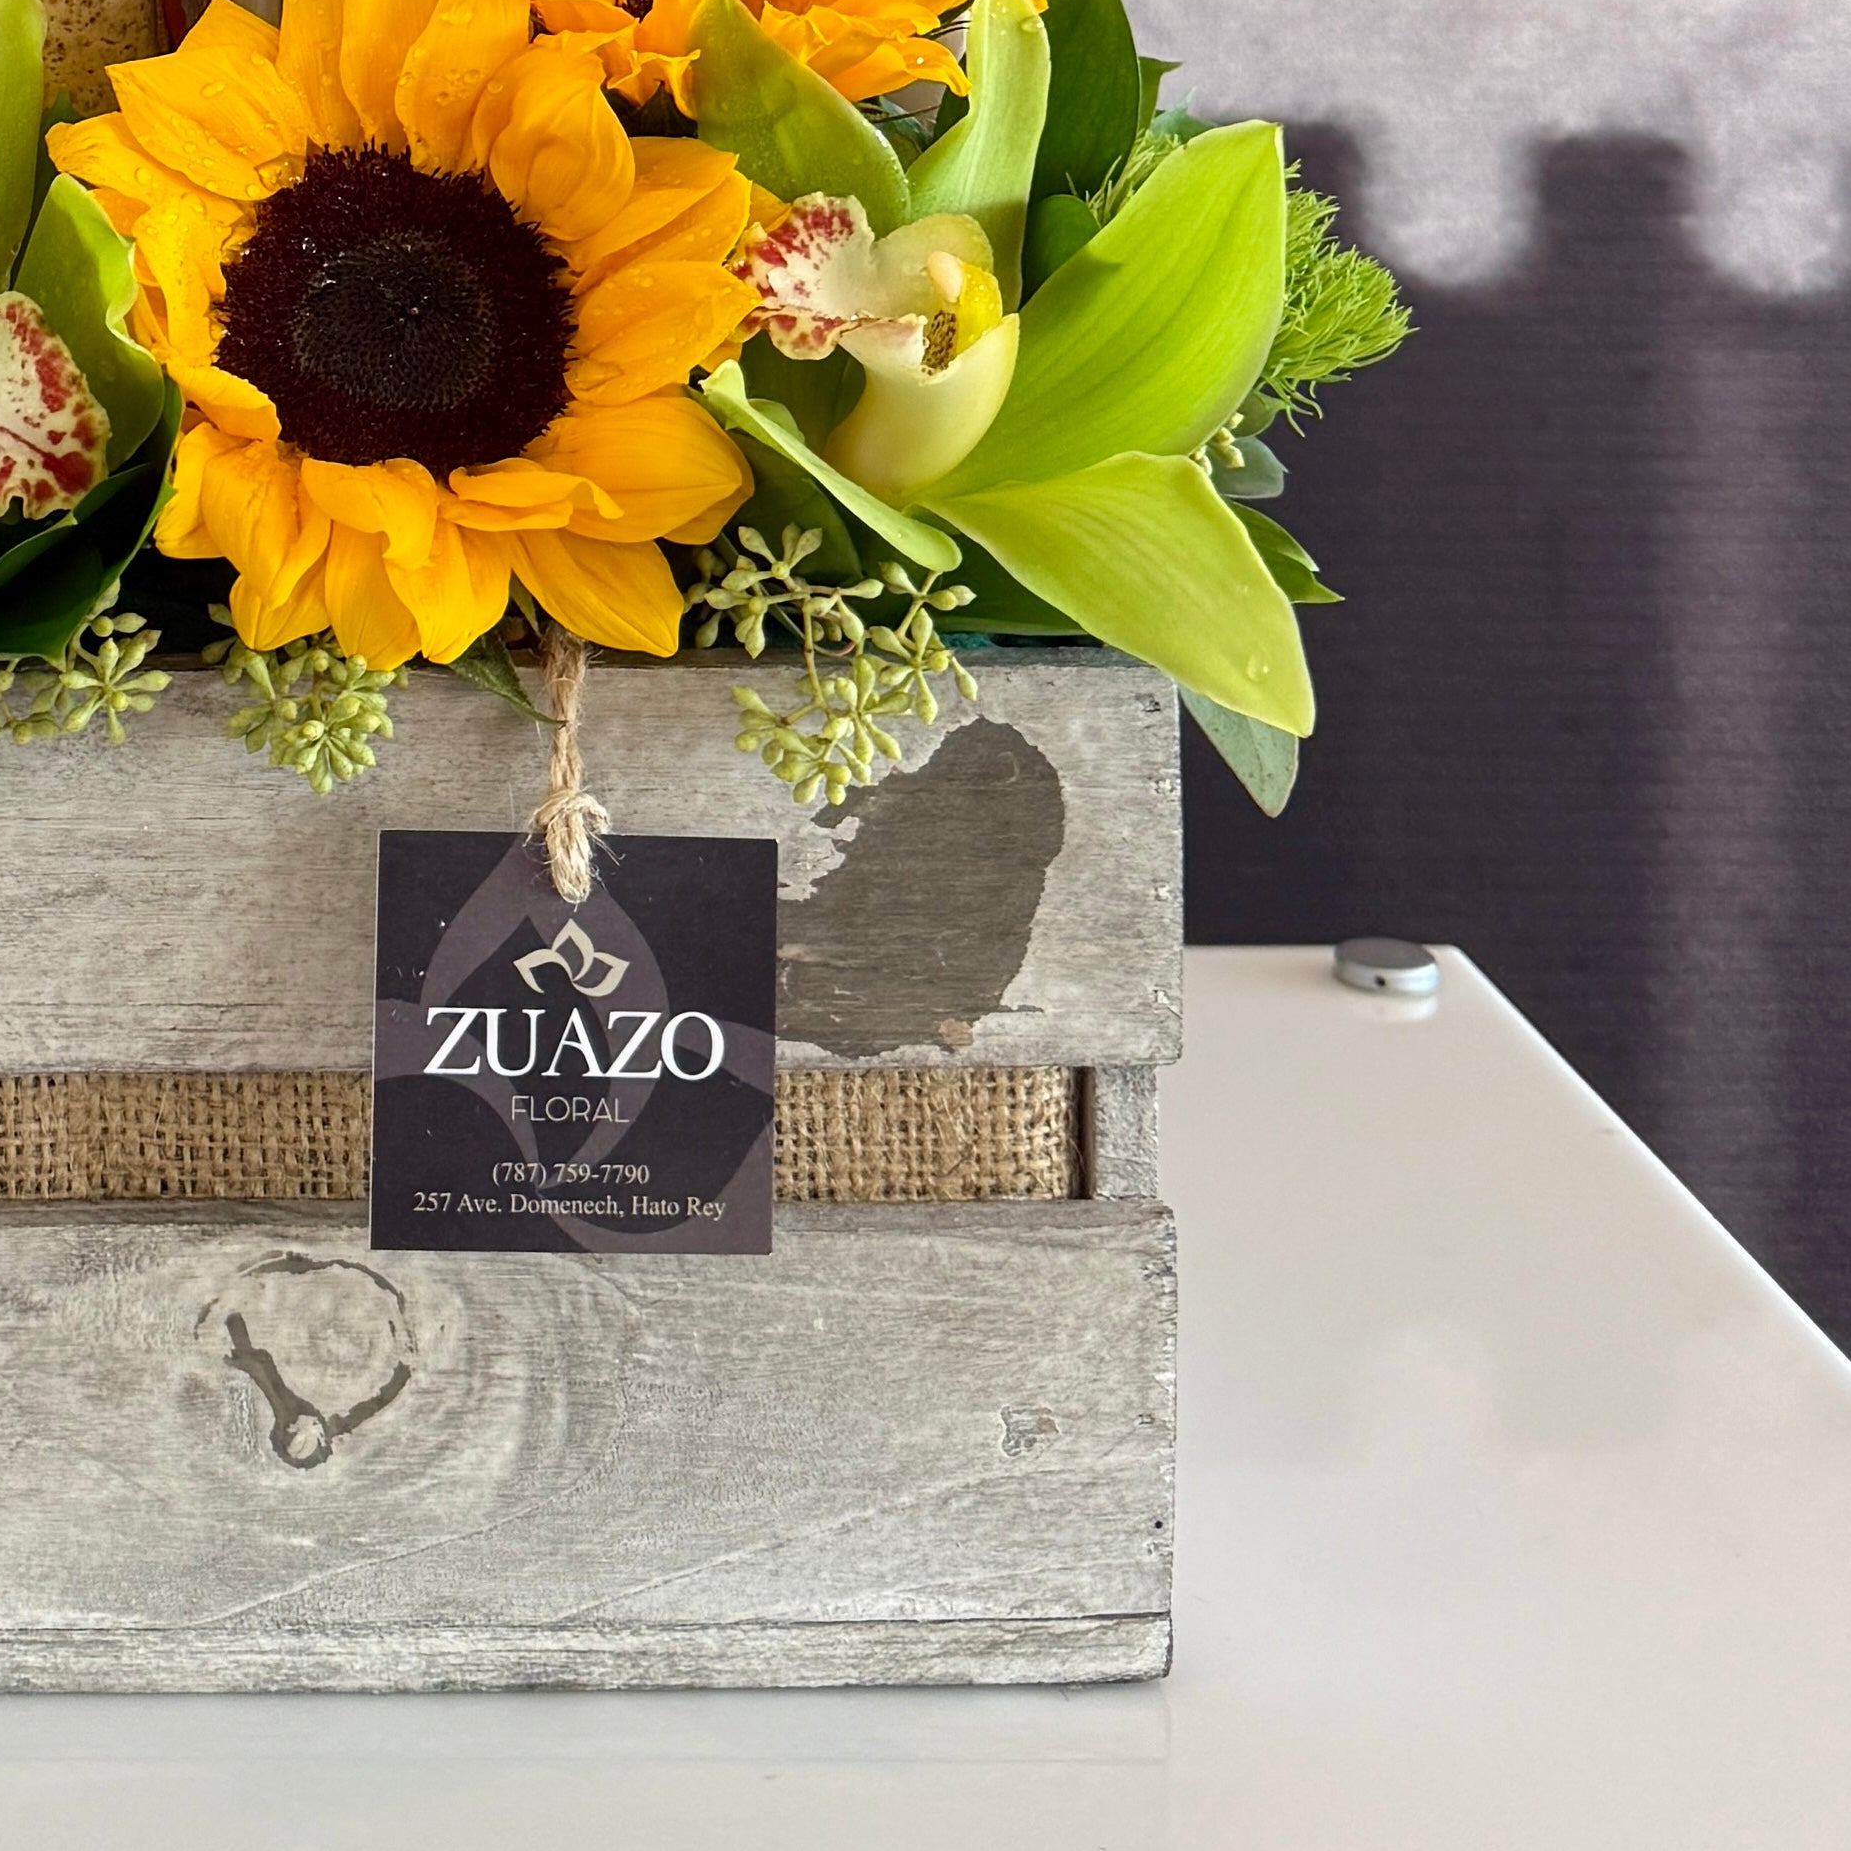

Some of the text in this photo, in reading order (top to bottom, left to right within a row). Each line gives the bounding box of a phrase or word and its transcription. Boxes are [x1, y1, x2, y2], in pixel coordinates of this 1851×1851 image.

[422, 1005, 726, 1081] ZUAZO
[511, 1094, 631, 1124] FLORAL
[492, 1161, 651, 1188] (787) 759-7790
[413, 1191, 726, 1222] 257 Ave. Domenech, Hato Rey
